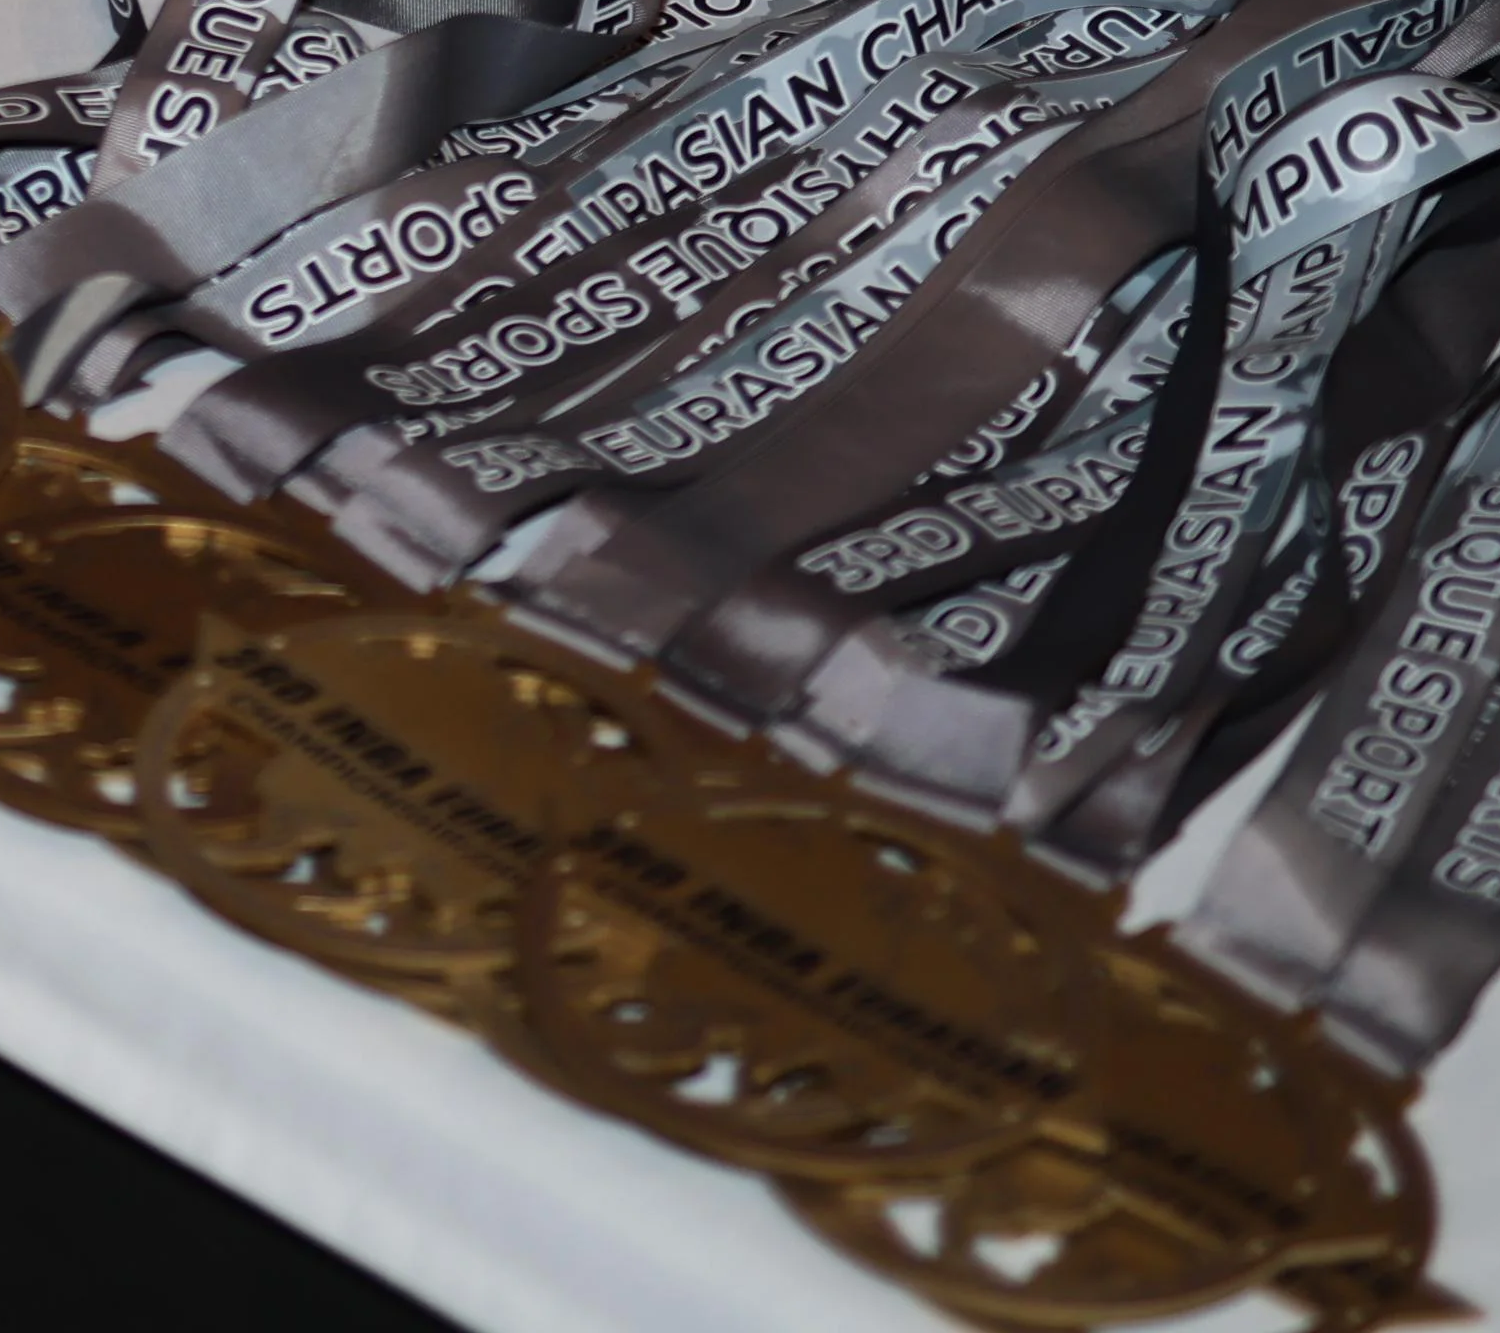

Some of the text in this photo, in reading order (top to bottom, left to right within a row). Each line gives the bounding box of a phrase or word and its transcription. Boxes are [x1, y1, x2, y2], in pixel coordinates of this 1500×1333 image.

[247, 174, 537, 345] SPORTS
[630, 67, 973, 300] PHYSIQUE
[365, 273, 649, 406] SPORTS
[580, 261, 923, 475] EURASIAN
[796, 508, 973, 594] 3RD
[1104, 401, 1281, 702] EURASIAN
[215, 645, 320, 709] 3RD
[311, 704, 433, 788] INBA
